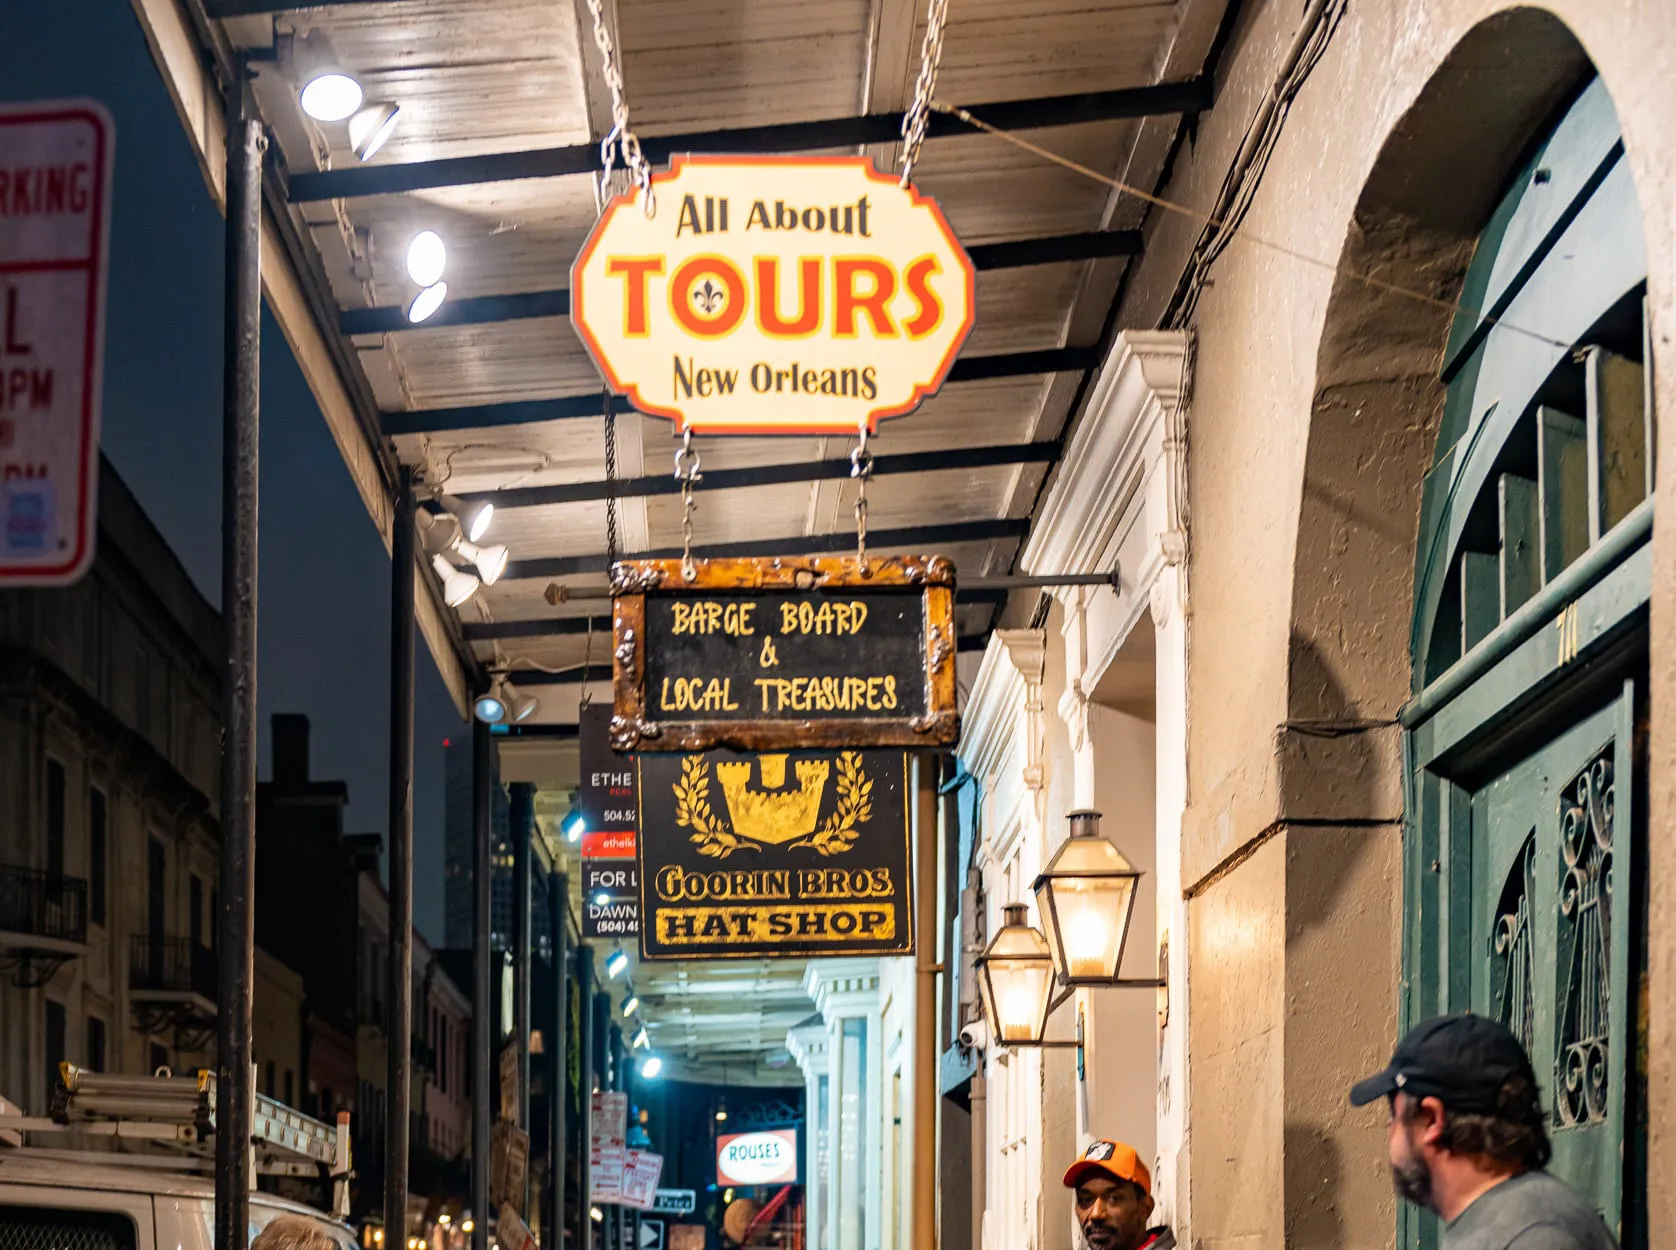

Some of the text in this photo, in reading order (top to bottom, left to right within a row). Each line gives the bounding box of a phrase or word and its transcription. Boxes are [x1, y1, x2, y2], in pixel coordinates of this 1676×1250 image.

[676, 193, 872, 238] All About
[605, 252, 944, 341] TOURS
[673, 354, 878, 400] New Orleans
[671, 601, 869, 637] BARGE BOARD
[759, 635, 780, 668] &
[660, 675, 898, 712] LOCAL TREASURES
[590, 870, 626, 887] FOR
[654, 864, 791, 902] GOORIN
[589, 903, 637, 919] DAWN
[664, 911, 888, 939] HAT SHOP
[729, 1142, 780, 1162] ROUSES
